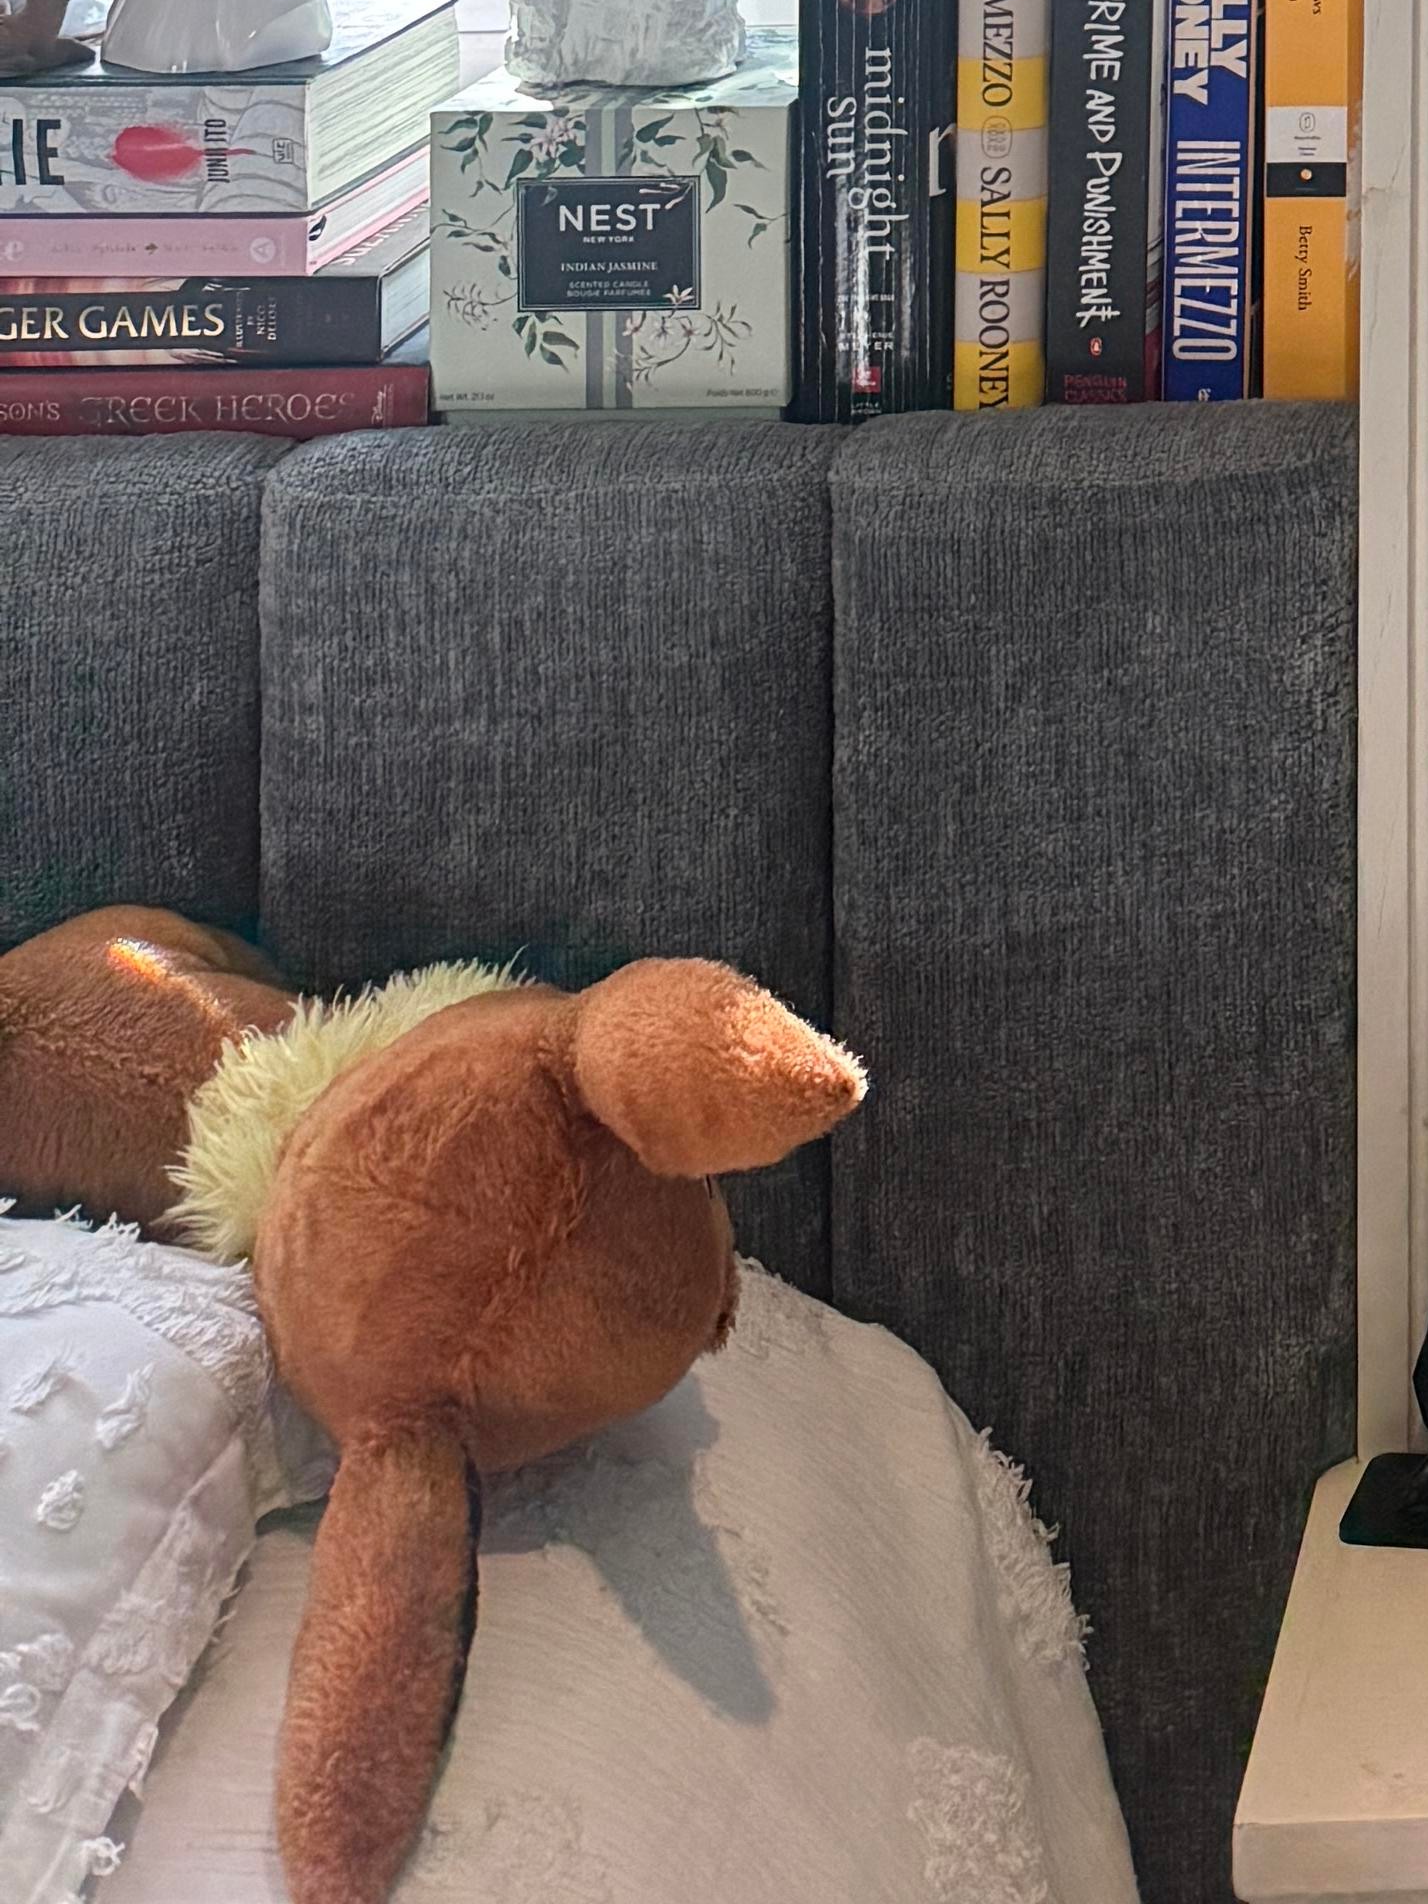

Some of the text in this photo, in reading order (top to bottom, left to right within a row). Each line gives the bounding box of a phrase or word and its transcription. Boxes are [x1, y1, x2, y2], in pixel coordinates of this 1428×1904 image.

[826, 96, 856, 179] sun
[849, 46, 908, 261] midnight
[1087, 89, 1116, 144] AND
[559, 203, 660, 232] NEST
[1076, 152, 1121, 328] PUNISHMENT
[1173, 141, 1240, 360] INTERMEZZO
[561, 260, 659, 272] INDIAN JASMINE
[1296, 225, 1312, 310] Betty Smith
[78, 303, 225, 340] GAMES
